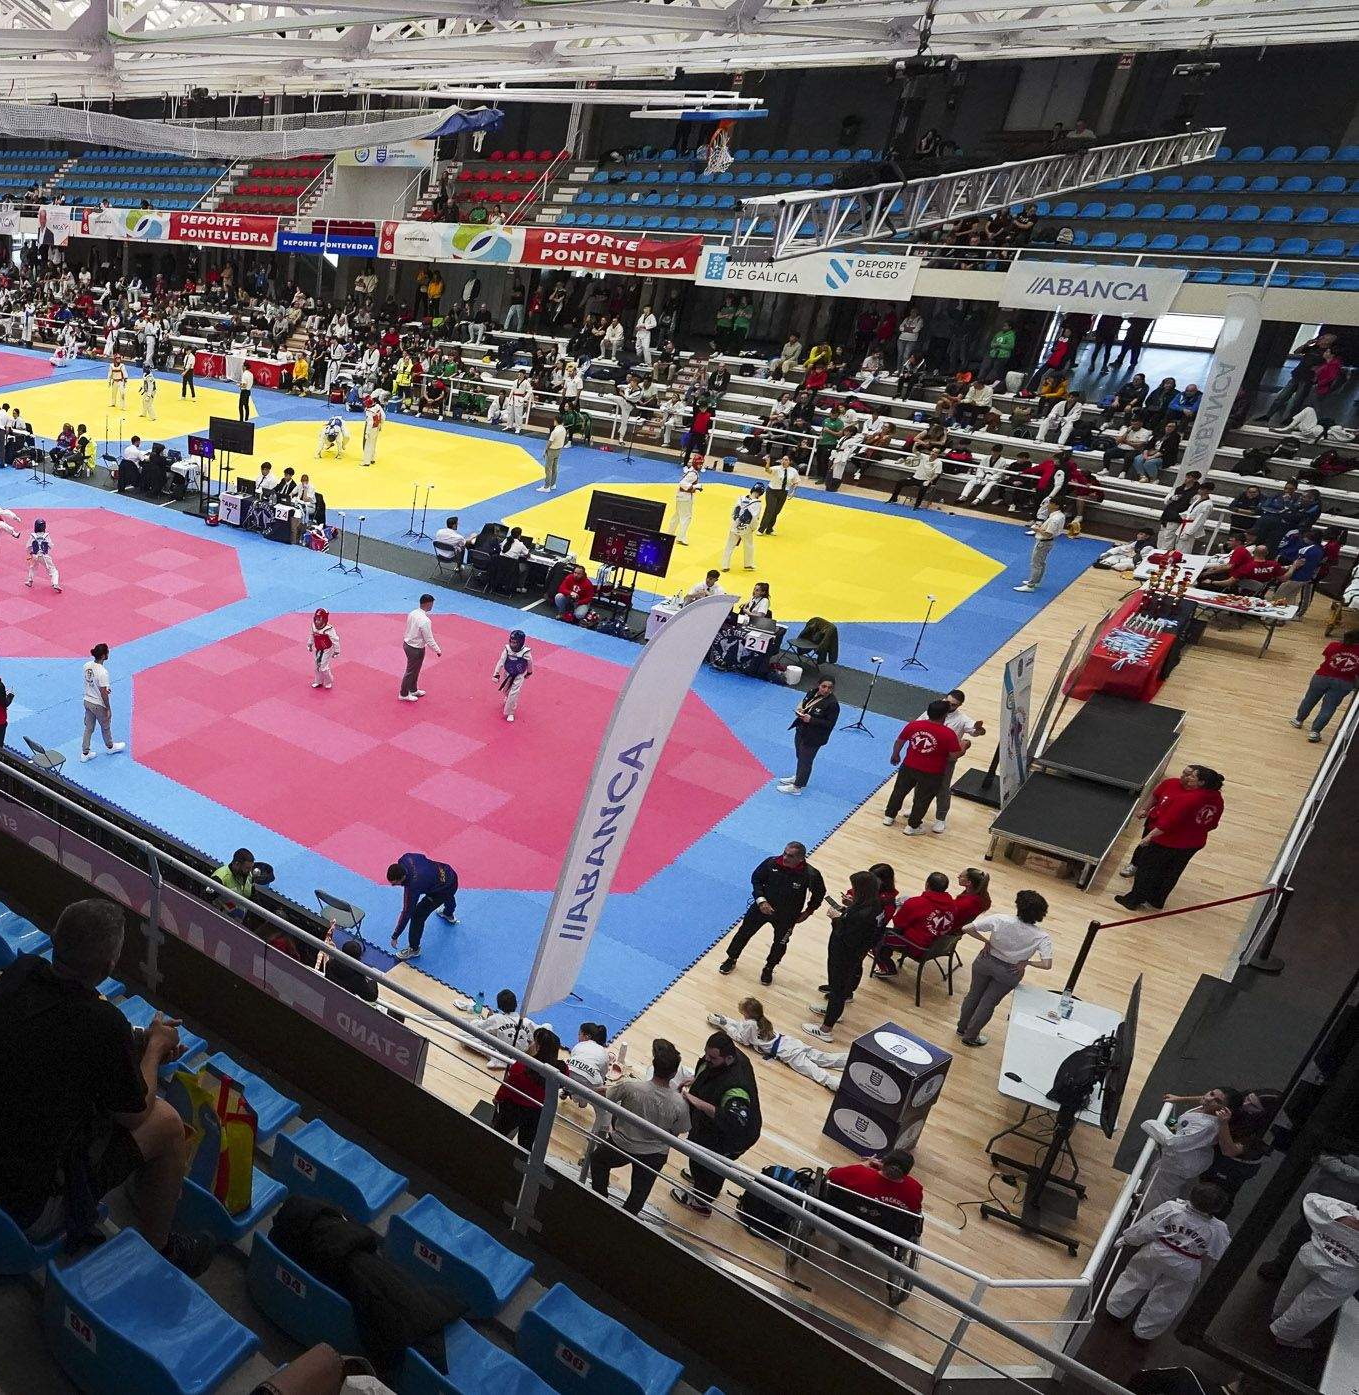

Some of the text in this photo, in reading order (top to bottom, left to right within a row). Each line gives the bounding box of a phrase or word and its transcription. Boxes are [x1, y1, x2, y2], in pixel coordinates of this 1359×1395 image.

[180, 214, 242, 227] DEPORTE
[180, 228, 269, 243] PONTEVEDRA
[543, 231, 640, 252] DEPORTE
[283, 239, 374, 251] DEPORTE PONTEVEDRA
[540, 248, 687, 270] PONTEVEDRA
[857, 259, 907, 270] DEPORTE
[727, 269, 799, 284] DE GALICIA
[855, 269, 899, 279] GALEGO
[226, 508, 232, 520] 7
[567, 1058, 597, 1078] NATURAL
